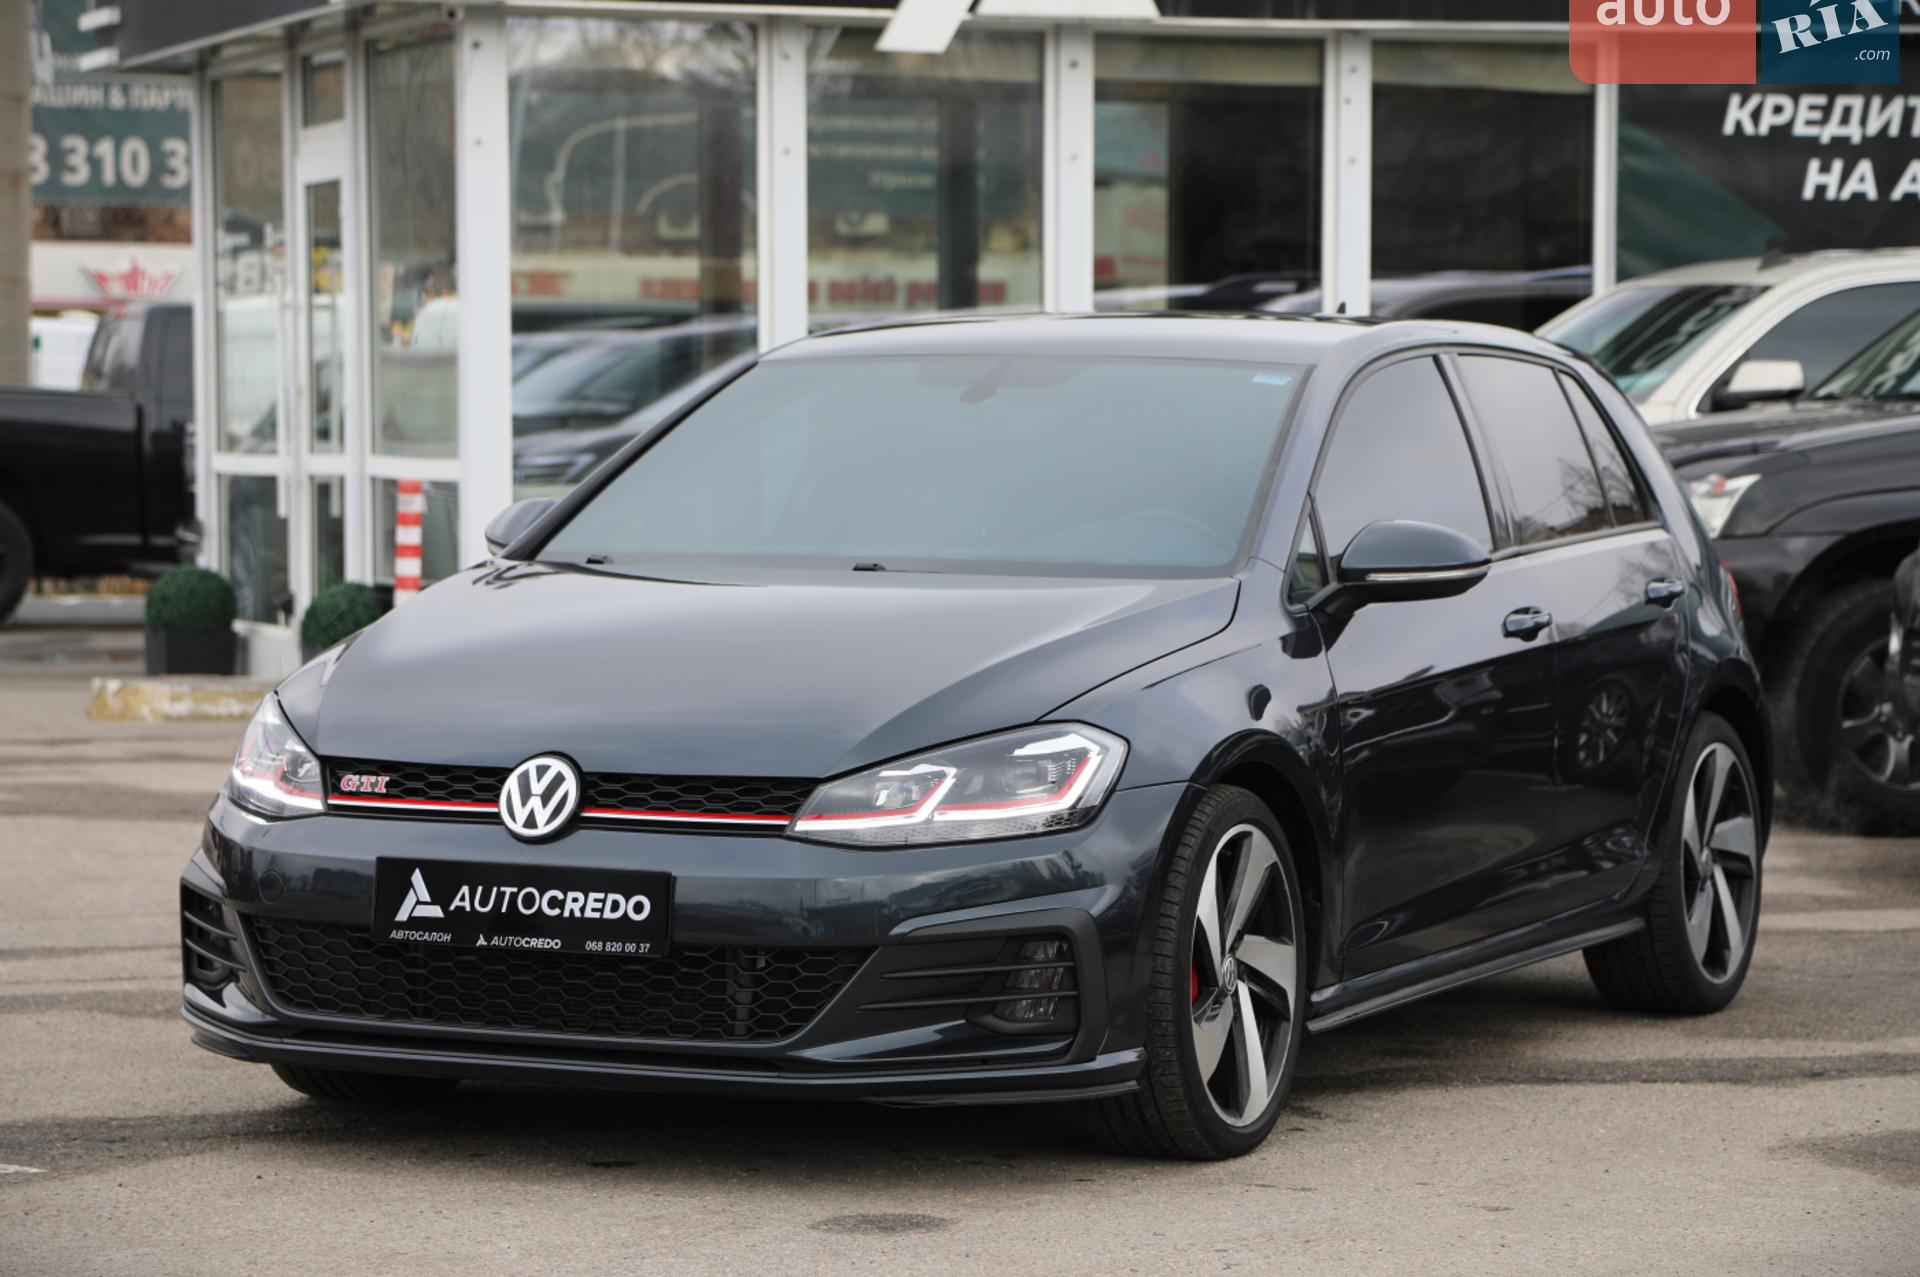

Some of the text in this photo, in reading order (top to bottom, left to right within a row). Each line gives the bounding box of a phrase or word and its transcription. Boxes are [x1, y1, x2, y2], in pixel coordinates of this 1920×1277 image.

[58, 133, 151, 189] 310
[159, 136, 190, 190] 3
[1801, 157, 1879, 202] НА
[340, 774, 390, 794] GTI
[448, 884, 652, 922] AUTOCREDO
[388, 929, 453, 943] АВТОСАЛОН
[490, 935, 562, 950] AUTOCREDO
[585, 940, 651, 954] 068 820 00 37
